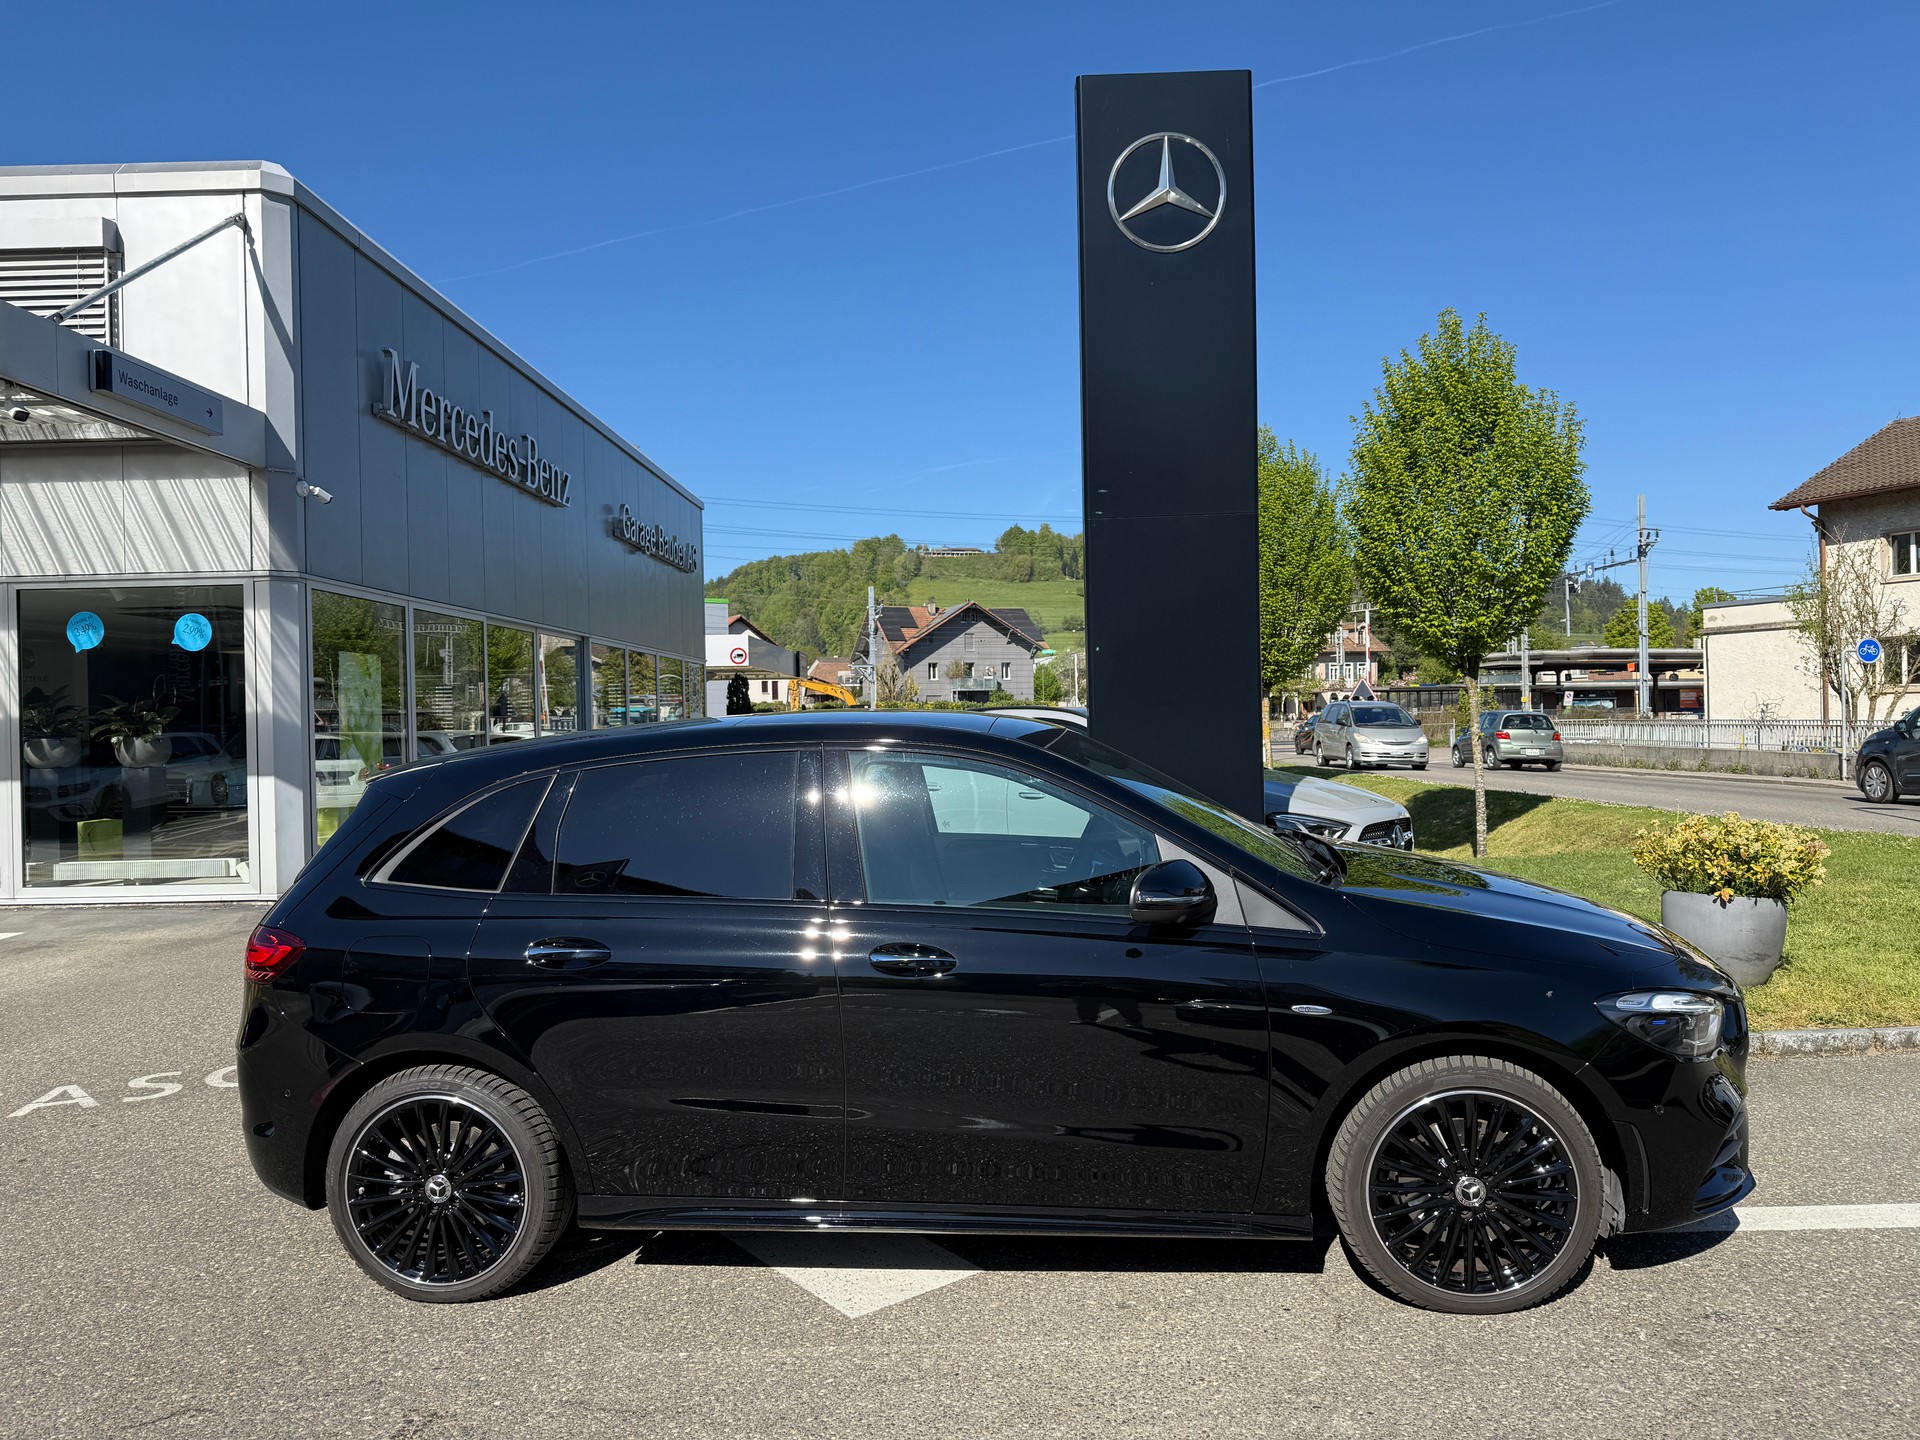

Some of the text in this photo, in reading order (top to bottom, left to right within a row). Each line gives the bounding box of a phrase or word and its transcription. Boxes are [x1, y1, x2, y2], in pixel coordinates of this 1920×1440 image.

[118, 369, 179, 406] Waschanlage
[381, 347, 571, 507] Mercedes-Benz
[621, 503, 656, 555] Garage
[1587, 564, 1593, 576] 6
